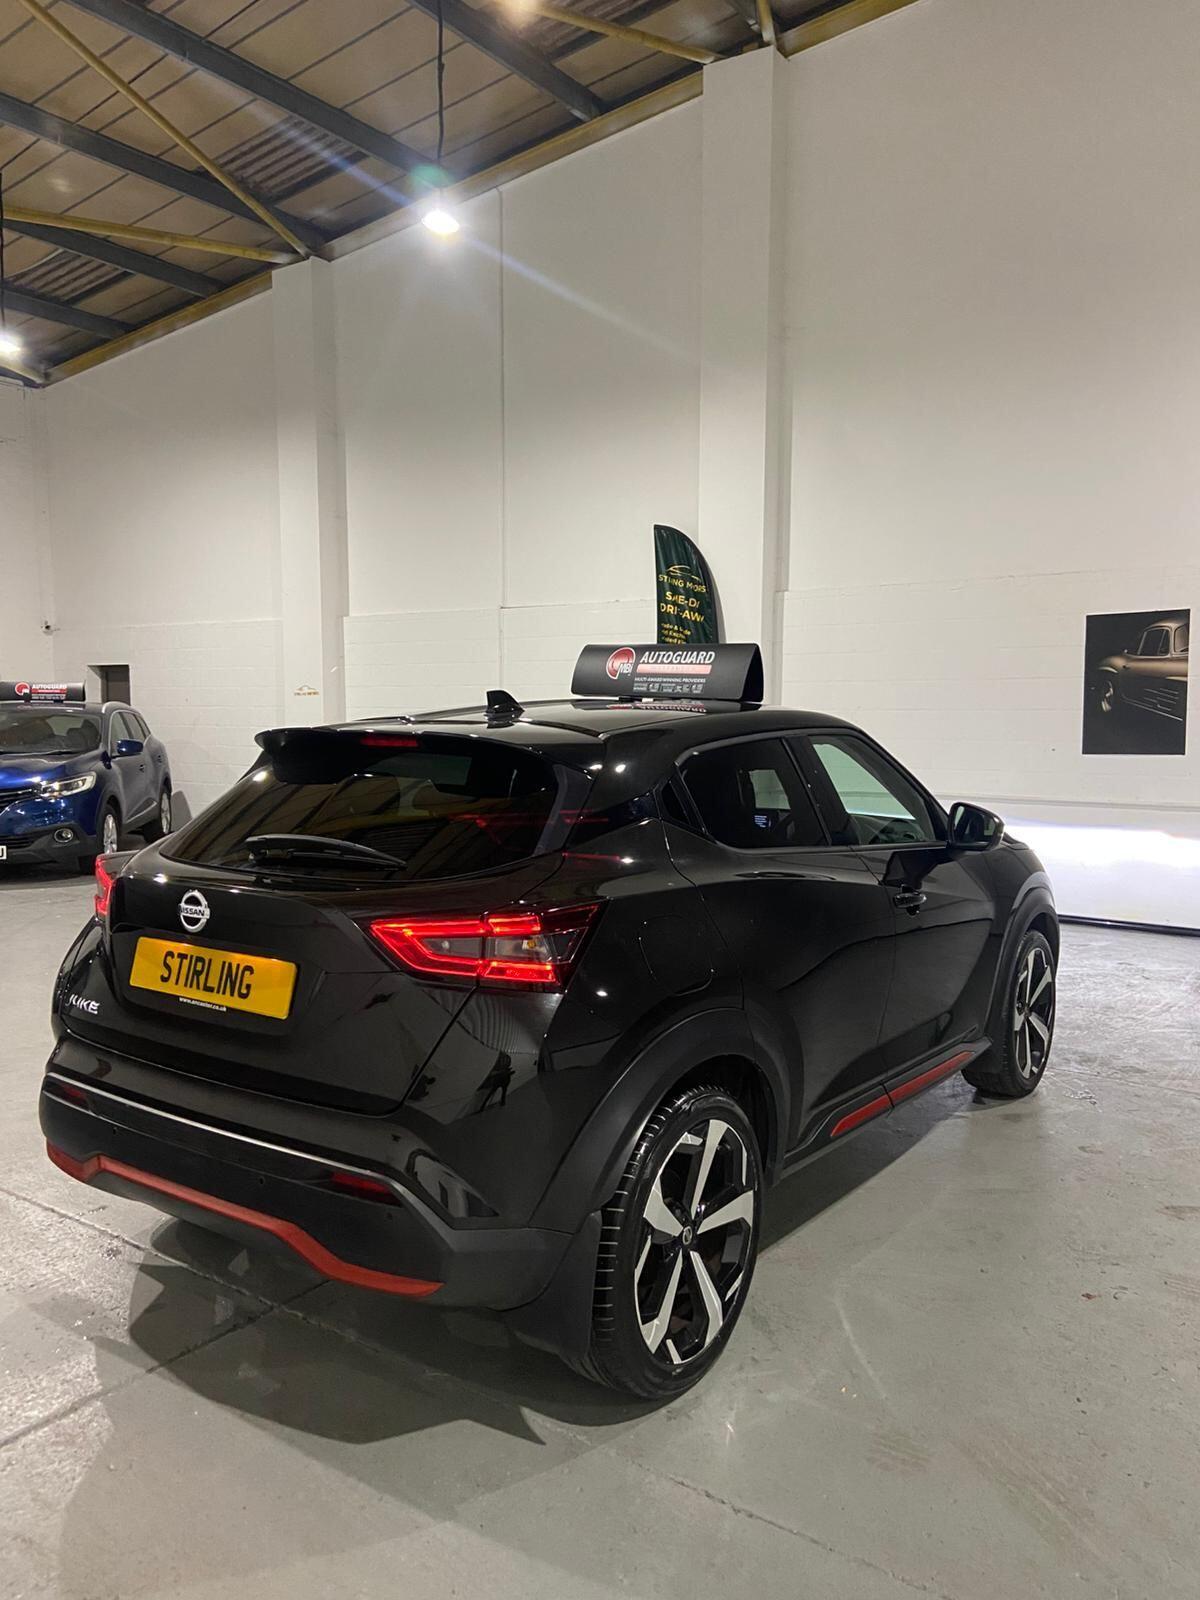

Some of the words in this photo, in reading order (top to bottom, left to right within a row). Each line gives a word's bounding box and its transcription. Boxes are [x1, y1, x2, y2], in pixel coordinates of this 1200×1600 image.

[640, 651, 715, 664] AUTOGUARD
[179, 906, 205, 917] NISSAN
[160, 950, 255, 1000] STIRLING
[65, 994, 100, 1015] JUKE
